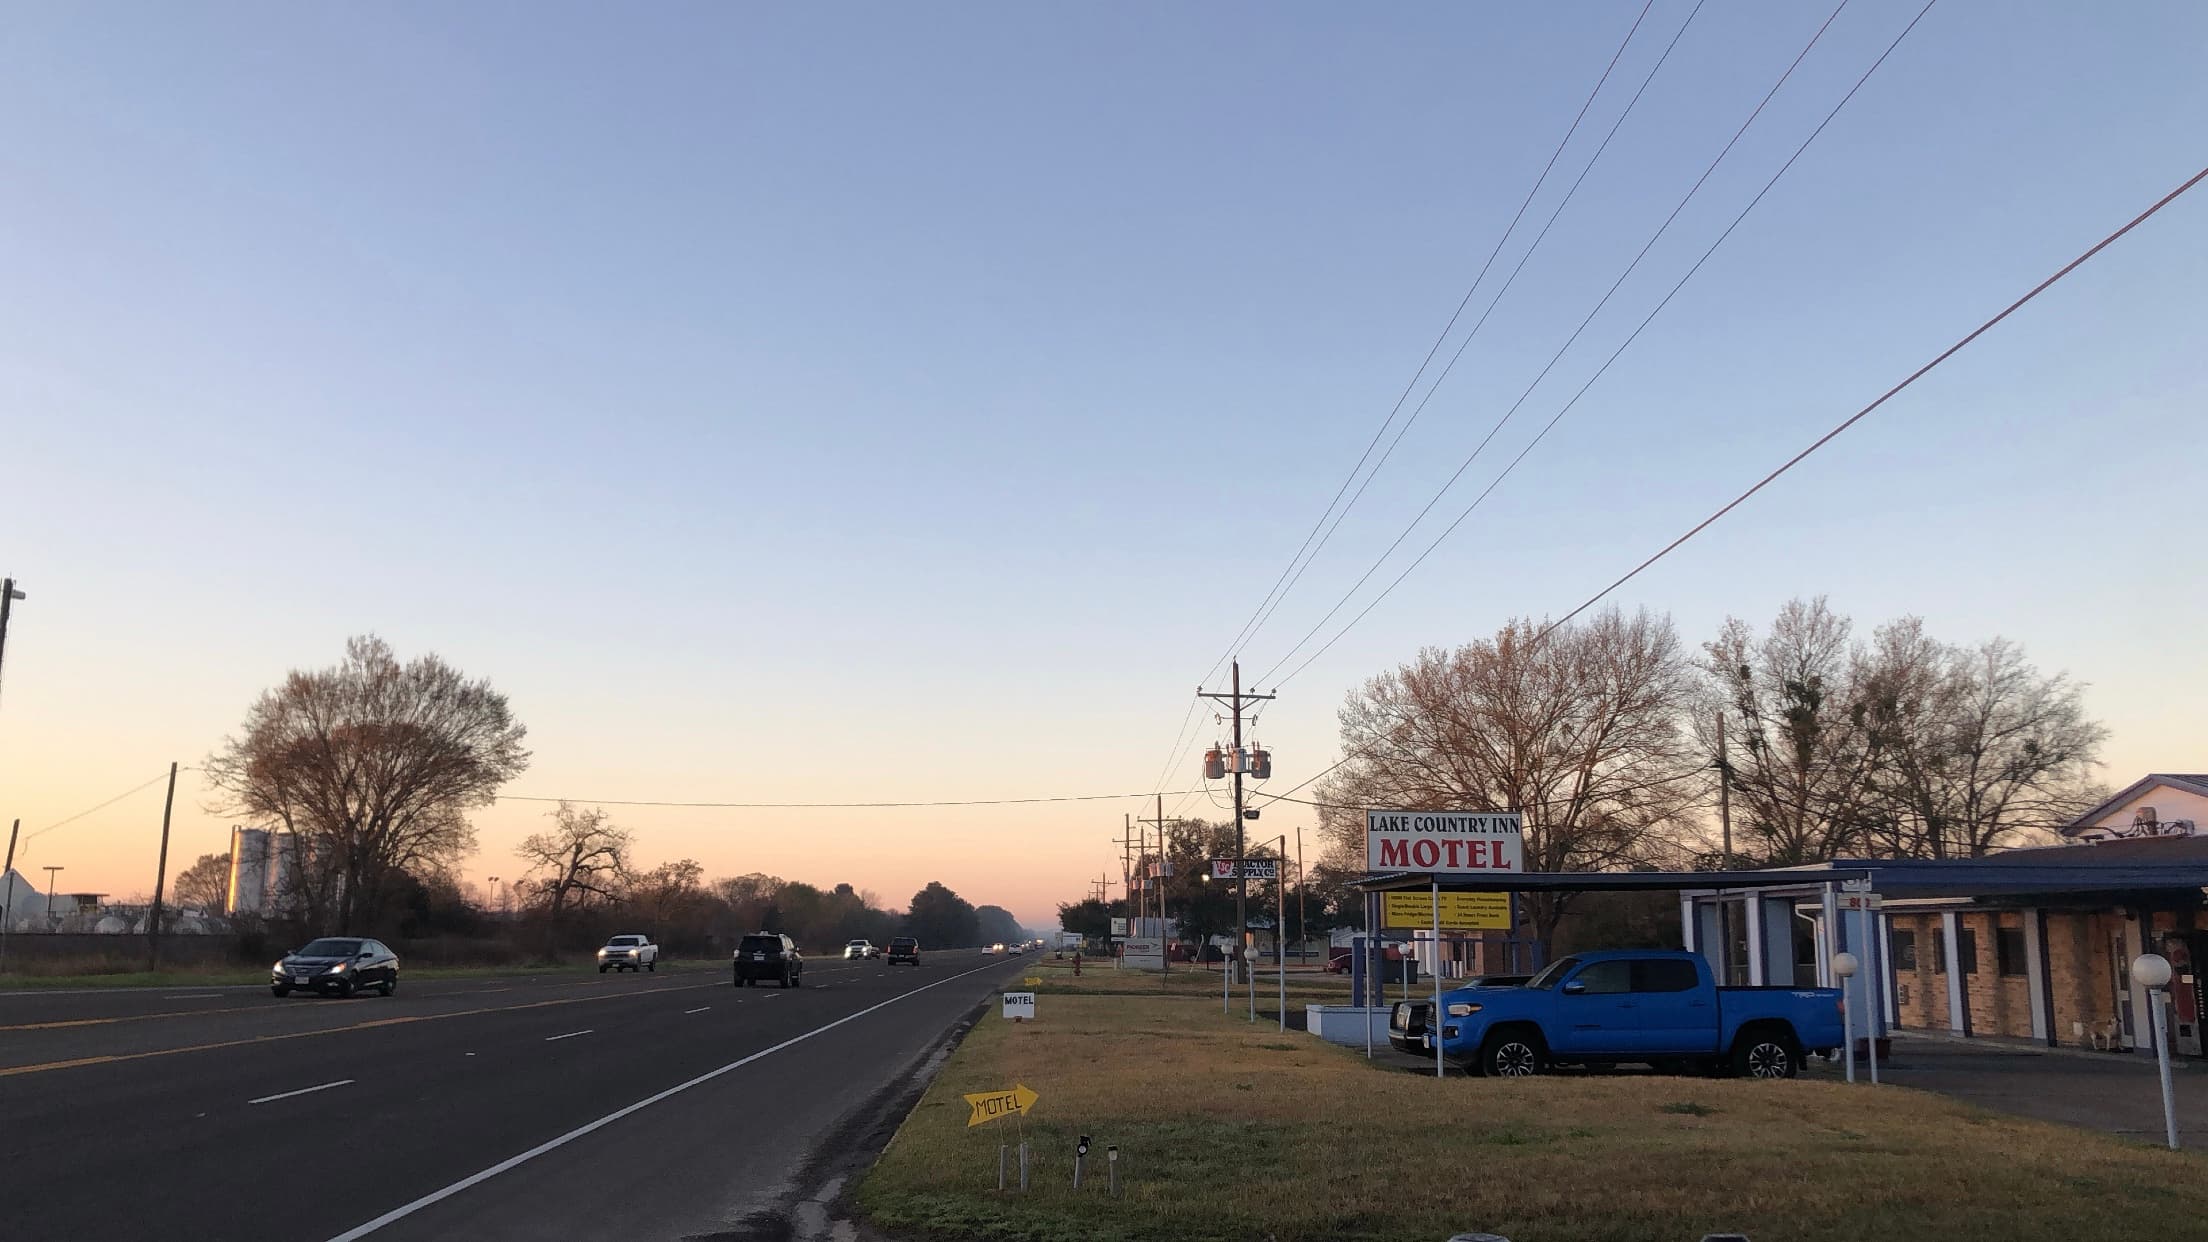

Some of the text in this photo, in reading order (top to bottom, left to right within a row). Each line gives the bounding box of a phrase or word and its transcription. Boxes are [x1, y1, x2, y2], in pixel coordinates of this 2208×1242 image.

[1369, 815, 1520, 834] LAKE COUNTRY INN
[1379, 838, 1511, 870] MOTEL
[1232, 859, 1274, 868] TACTOR
[1232, 868, 1263, 877] SPPLY
[1004, 996, 1034, 1005] MOTEL
[975, 1093, 1023, 1119] MOTEL
